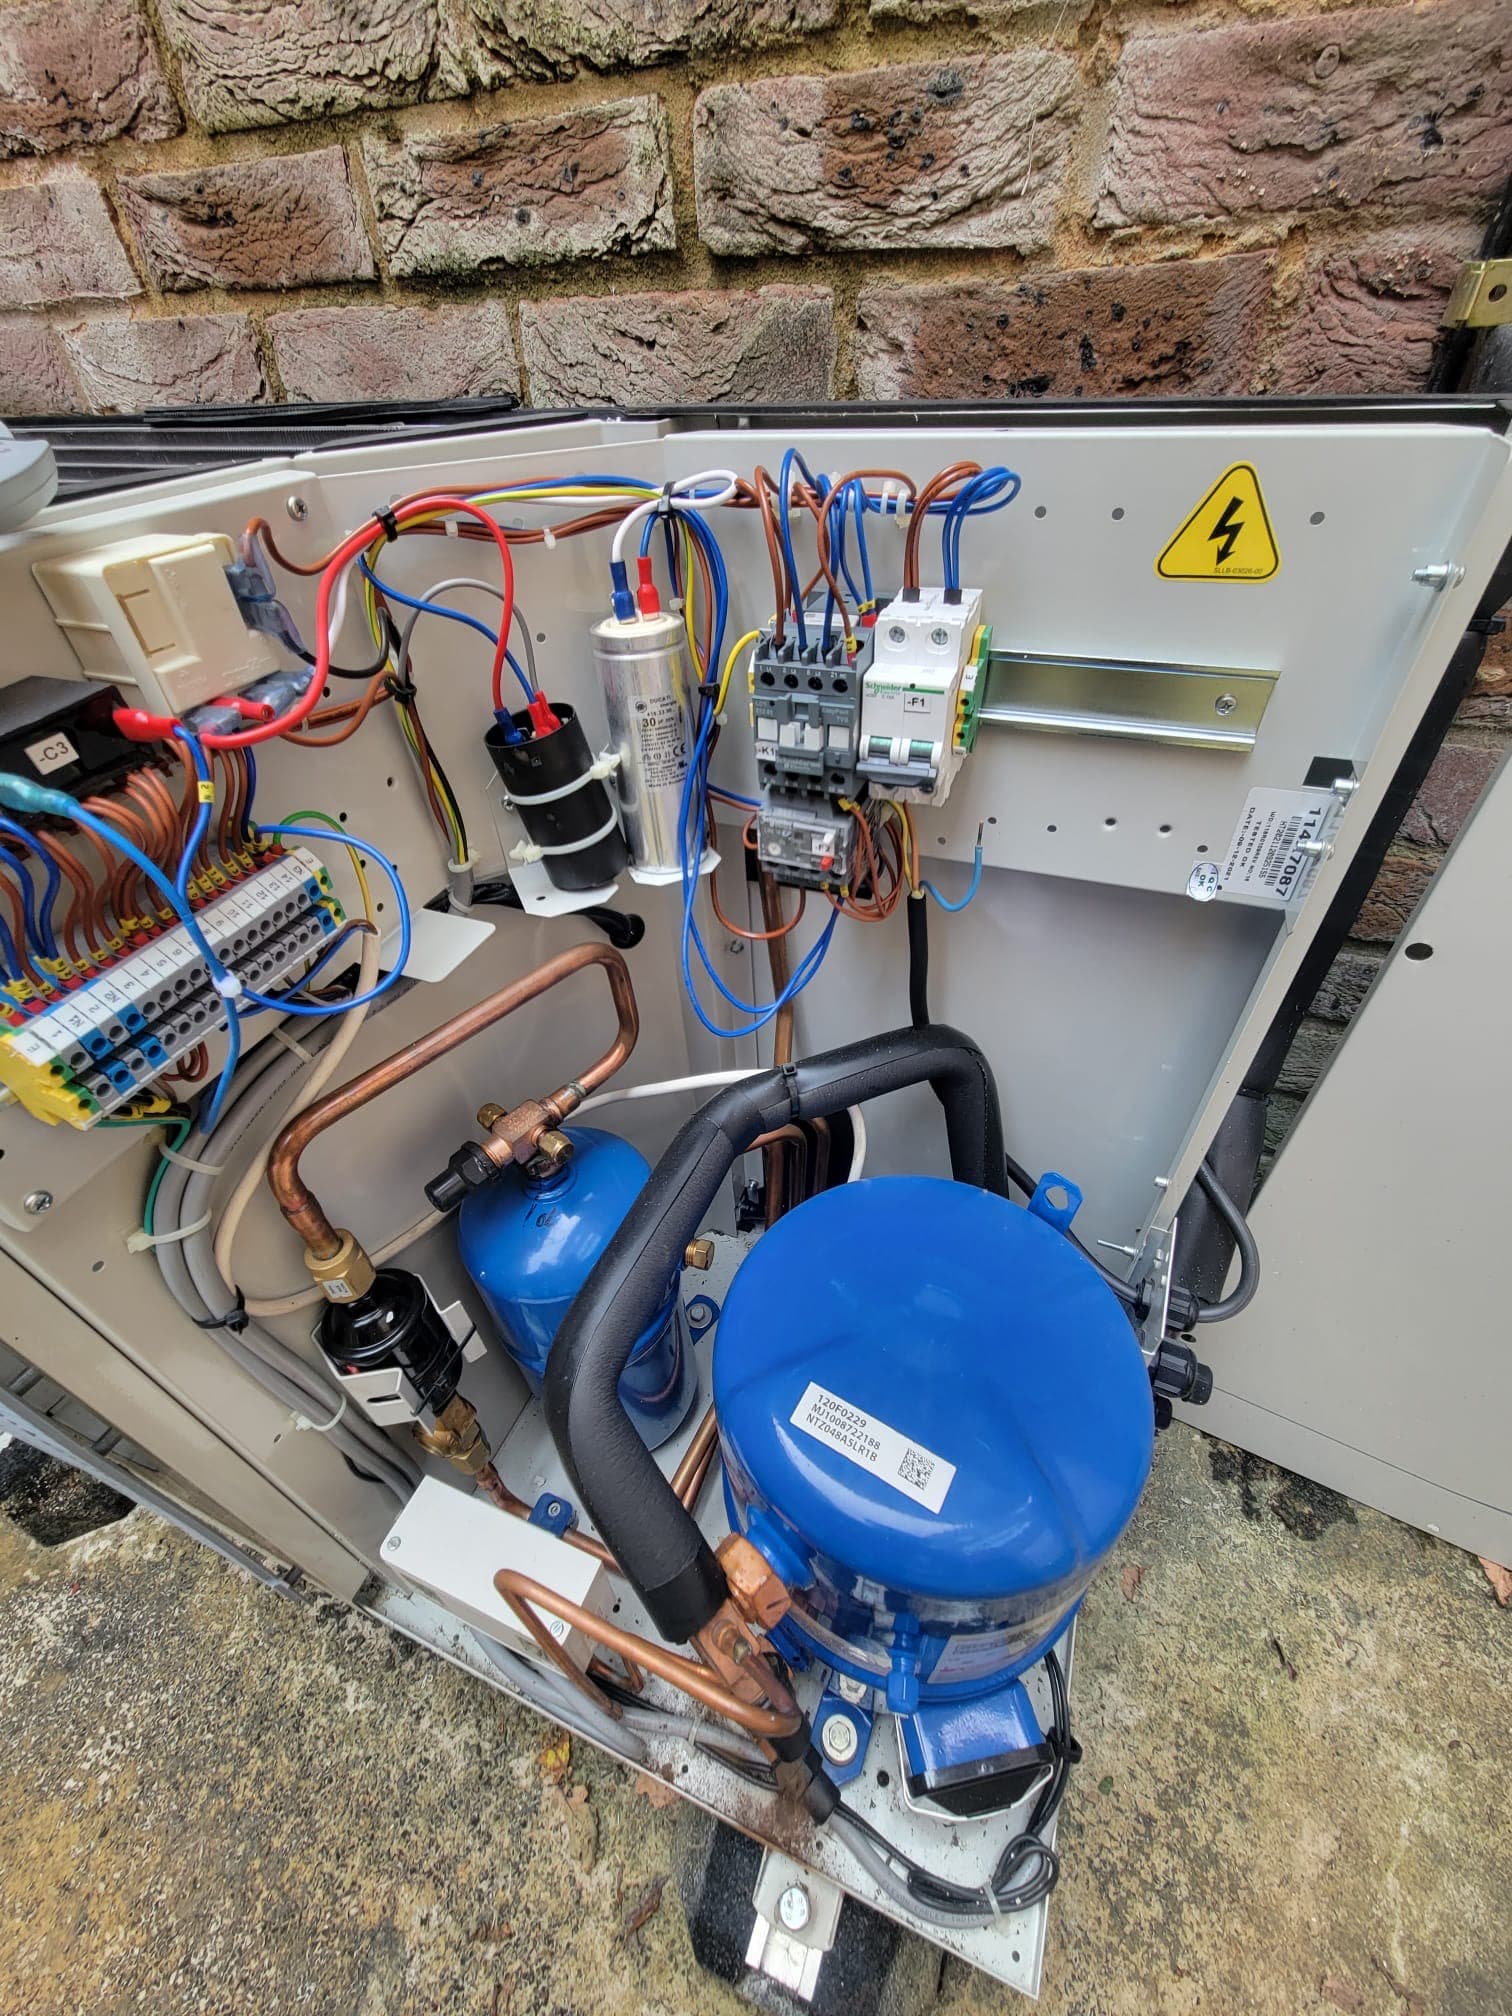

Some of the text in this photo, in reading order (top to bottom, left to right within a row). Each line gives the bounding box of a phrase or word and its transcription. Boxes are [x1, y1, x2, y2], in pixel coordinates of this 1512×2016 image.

[907, 697, 925, 707] -F1
[642, 718, 656, 728] 30
[38, 741, 69, 763] -C3
[758, 747, 775, 756] -K1
[1245, 820, 1262, 853] TESTED
[1276, 808, 1322, 897] 1147087
[818, 1394, 867, 1428] 120F0229
[811, 1404, 880, 1450] MJ1008722188
